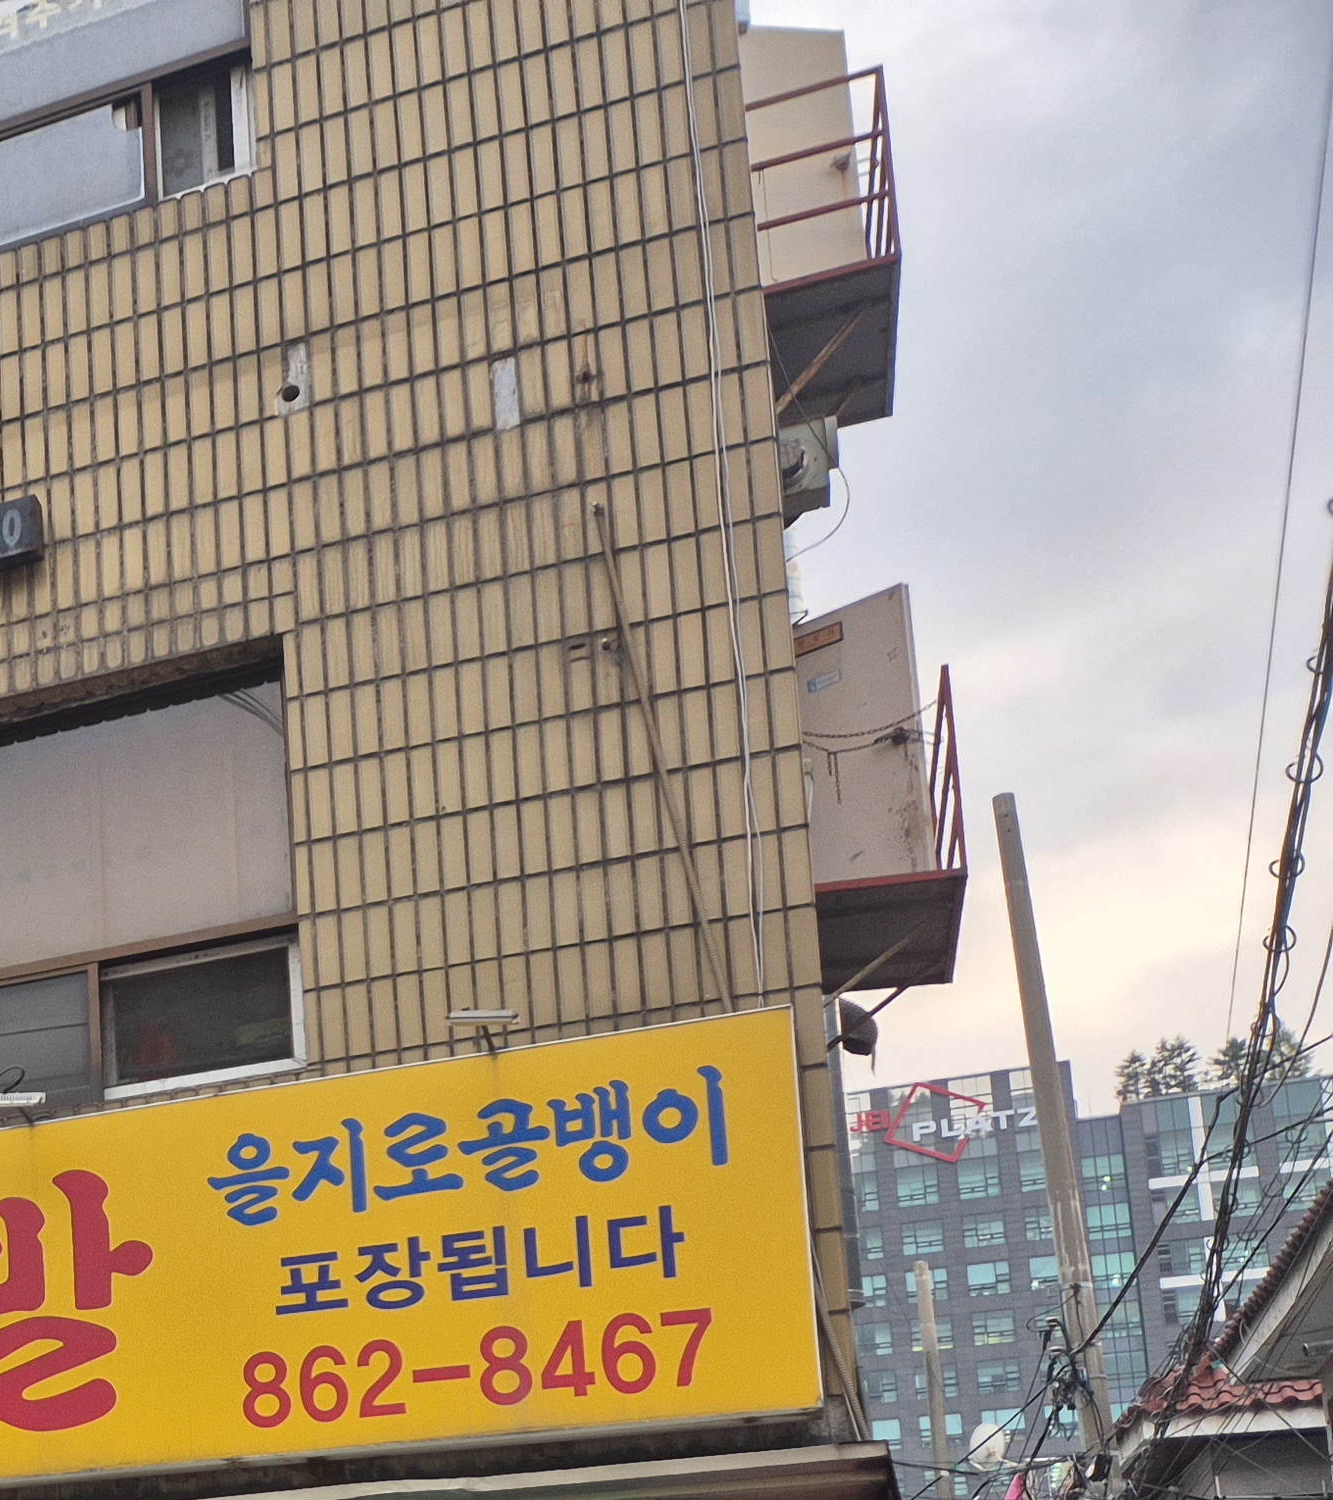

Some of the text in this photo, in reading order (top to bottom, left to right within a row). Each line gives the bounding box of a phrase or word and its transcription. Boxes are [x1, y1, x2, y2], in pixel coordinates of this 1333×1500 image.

[207, 1062, 731, 1232] 을지로골뱅이
[911, 1106, 1038, 1143] PLATZ
[276, 1203, 684, 1316] 포장됩니다
[239, 1306, 714, 1432] 862-8467
